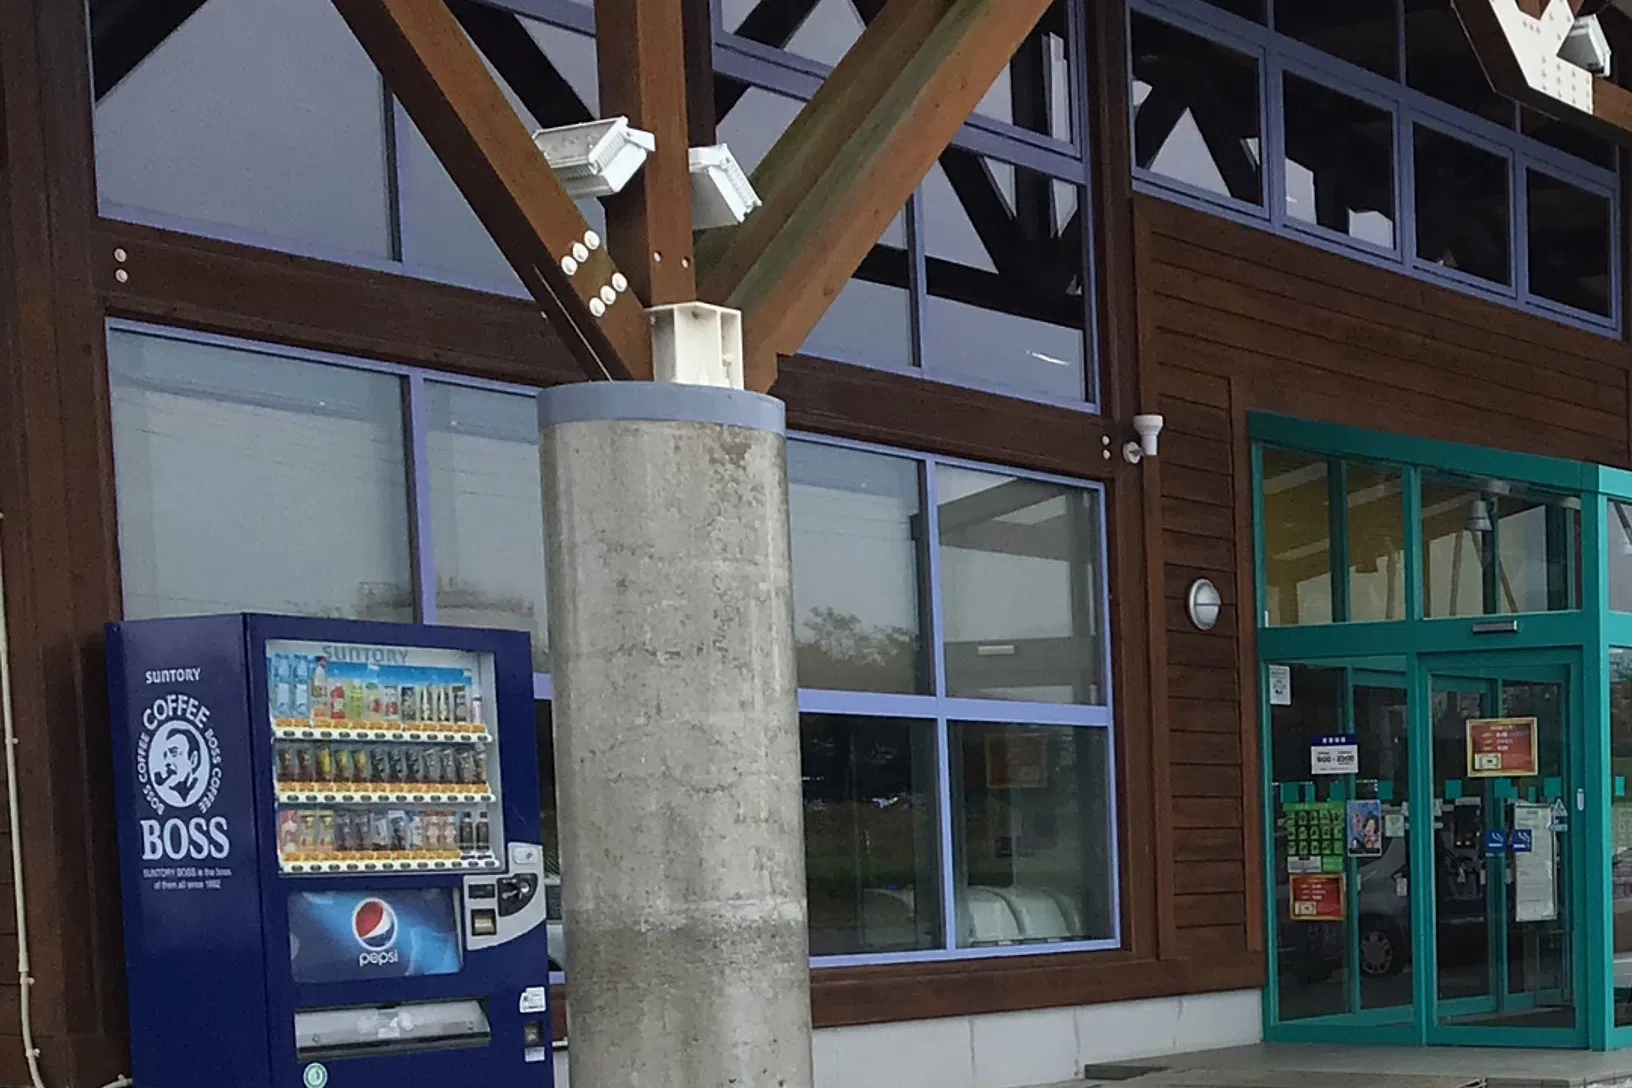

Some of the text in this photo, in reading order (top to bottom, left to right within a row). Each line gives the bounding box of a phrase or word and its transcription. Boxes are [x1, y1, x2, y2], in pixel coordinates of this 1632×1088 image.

[321, 645, 409, 664] SUNTORY
[145, 667, 201, 684] SUNTORY
[143, 694, 211, 730] COFFEE
[137, 732, 165, 815] BOSS COFFEE
[198, 728, 222, 814] BOSS COFFEE
[140, 816, 230, 860] BOSS
[359, 949, 399, 967] pepsi
